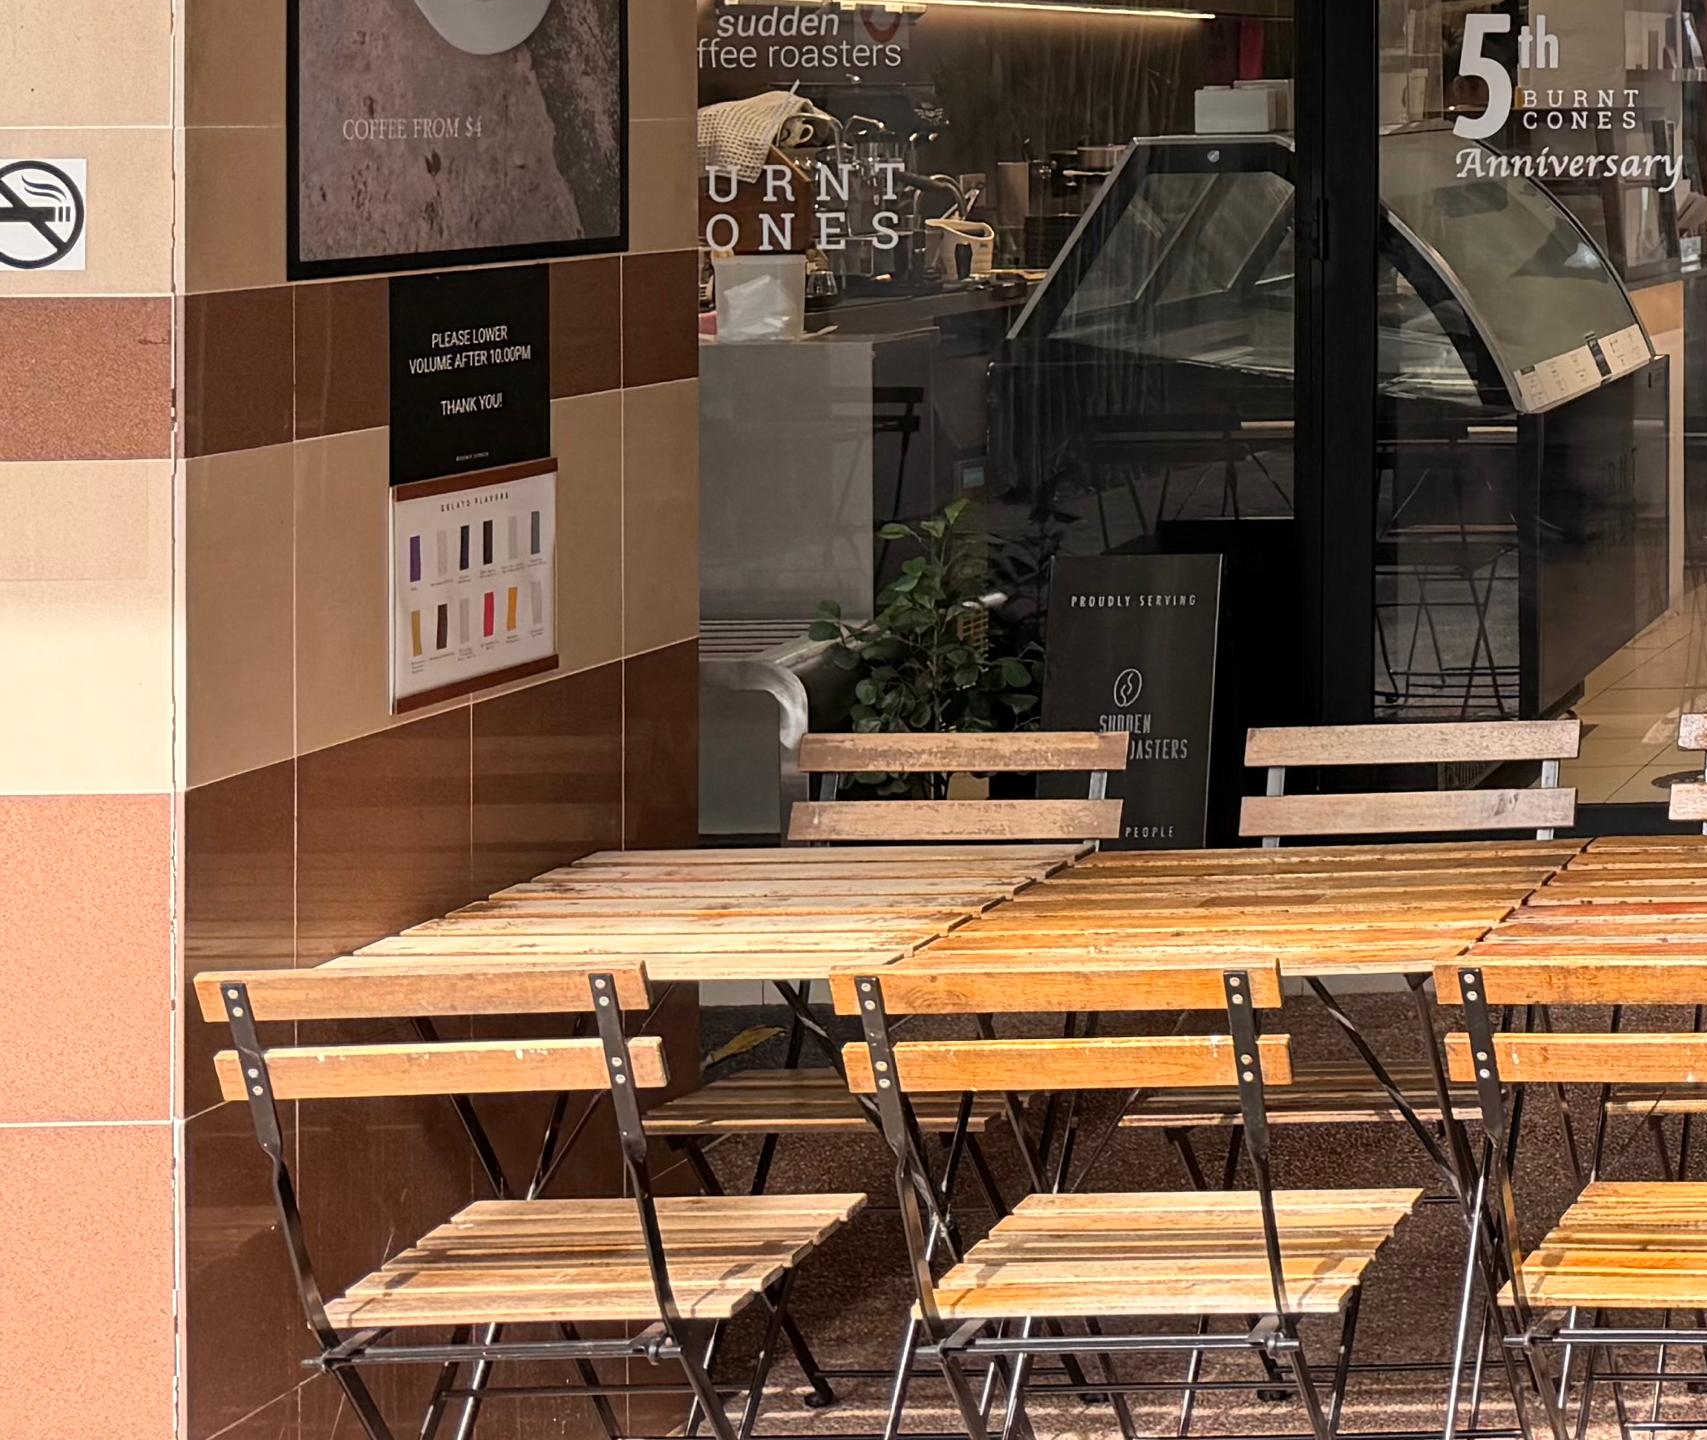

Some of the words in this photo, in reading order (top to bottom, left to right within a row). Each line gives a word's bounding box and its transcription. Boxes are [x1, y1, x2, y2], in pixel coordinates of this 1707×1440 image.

[716, 6, 839, 38] sudden
[769, 40, 901, 68] roasters
[1452, 13, 1559, 139] 5th
[1523, 89, 1639, 108] BURNT
[342, 118, 407, 140] COFFEE
[413, 116, 460, 139] FROM
[464, 115, 482, 139] $4
[1523, 111, 1637, 129] CONES
[1456, 147, 1684, 193] Anniversary
[431, 329, 471, 349] PLEASE
[472, 325, 508, 345] LOWER
[409, 354, 453, 375] VOLUME
[454, 349, 488, 369] AFTER
[490, 344, 531, 365] 10.00PM
[440, 396, 477, 416] THANK
[478, 392, 503, 412] YOU!
[1070, 595, 1131, 607] PROUDLY
[1139, 594, 1197, 607] SERVING
[1099, 713, 1151, 734] SUDDEN
[1125, 825, 1174, 839] PEOPLE
